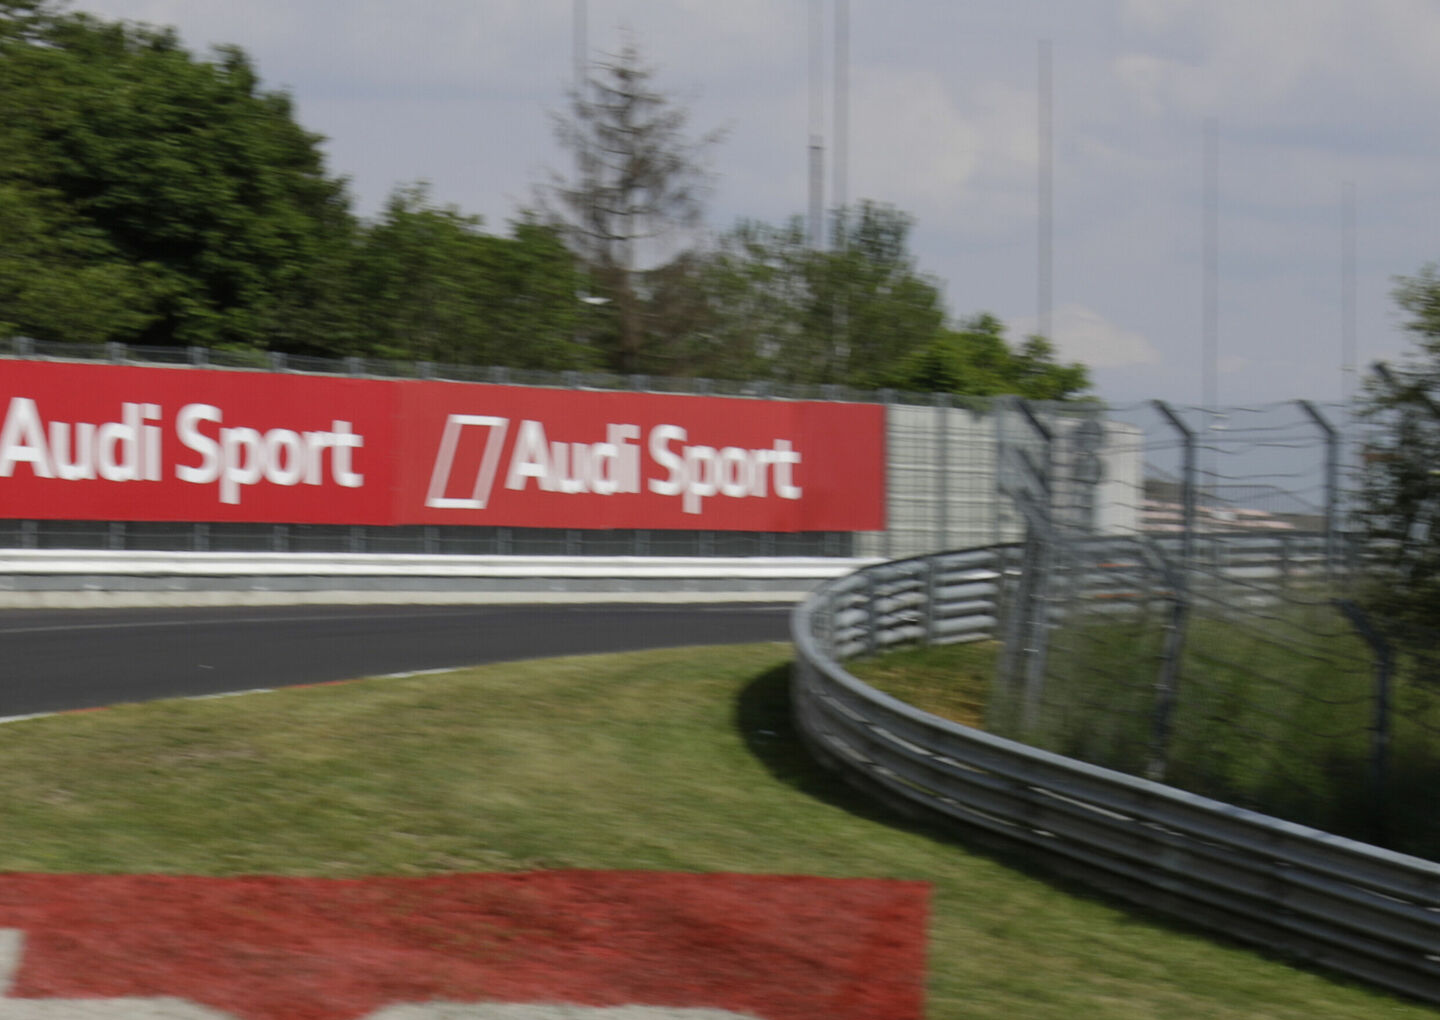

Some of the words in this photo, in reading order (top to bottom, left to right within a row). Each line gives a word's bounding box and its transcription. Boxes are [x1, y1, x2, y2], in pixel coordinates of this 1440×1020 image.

[175, 403, 364, 505] Sport
[504, 419, 640, 494] Audi
[648, 424, 802, 514] Sport
